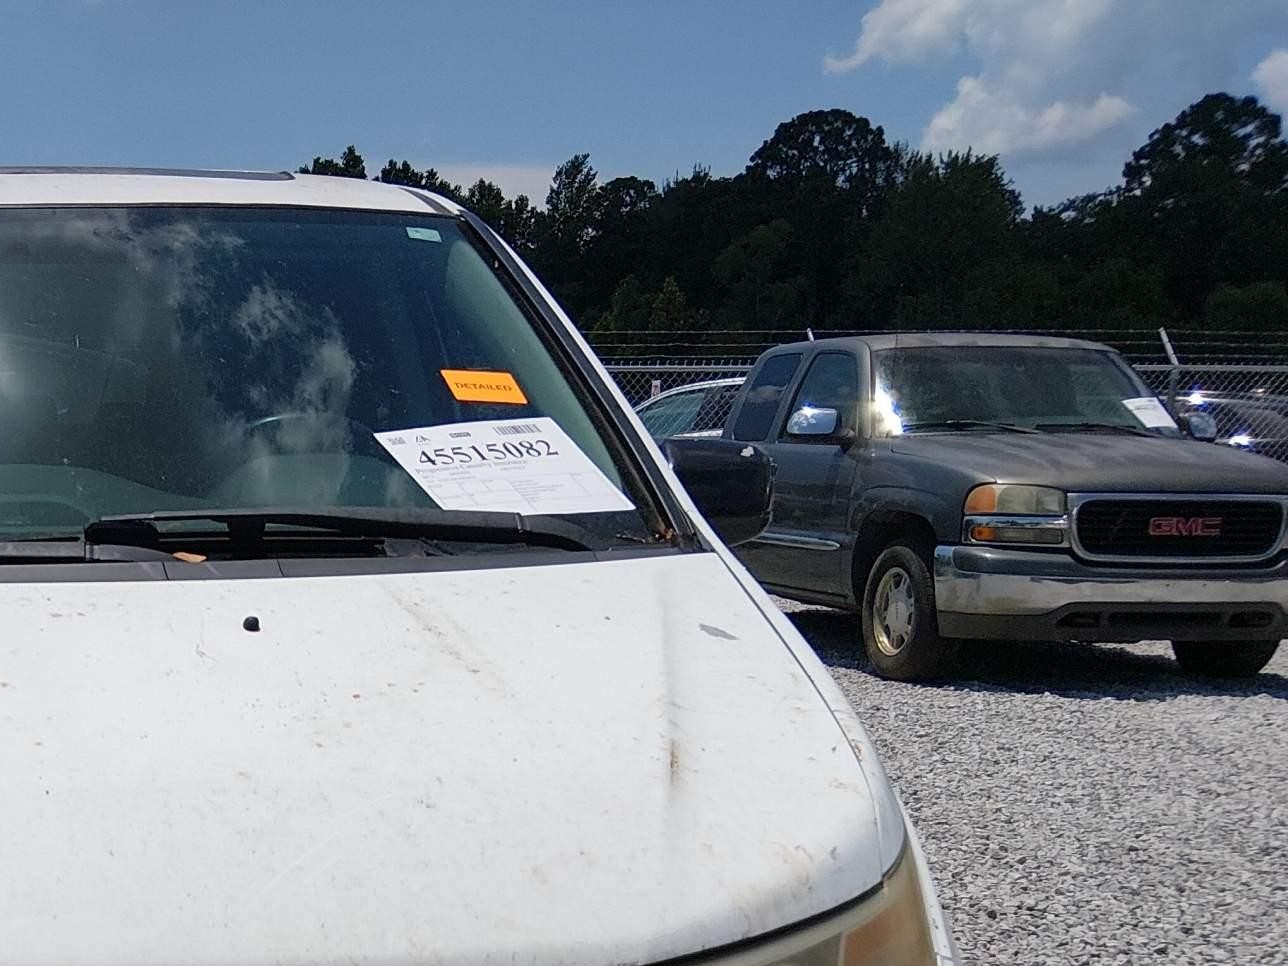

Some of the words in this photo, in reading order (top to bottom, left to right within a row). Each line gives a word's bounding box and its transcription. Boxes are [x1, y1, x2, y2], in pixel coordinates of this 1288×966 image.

[454, 382, 513, 392] DETAILED
[419, 439, 559, 466] 45515082
[1149, 516, 1223, 536] GMC
